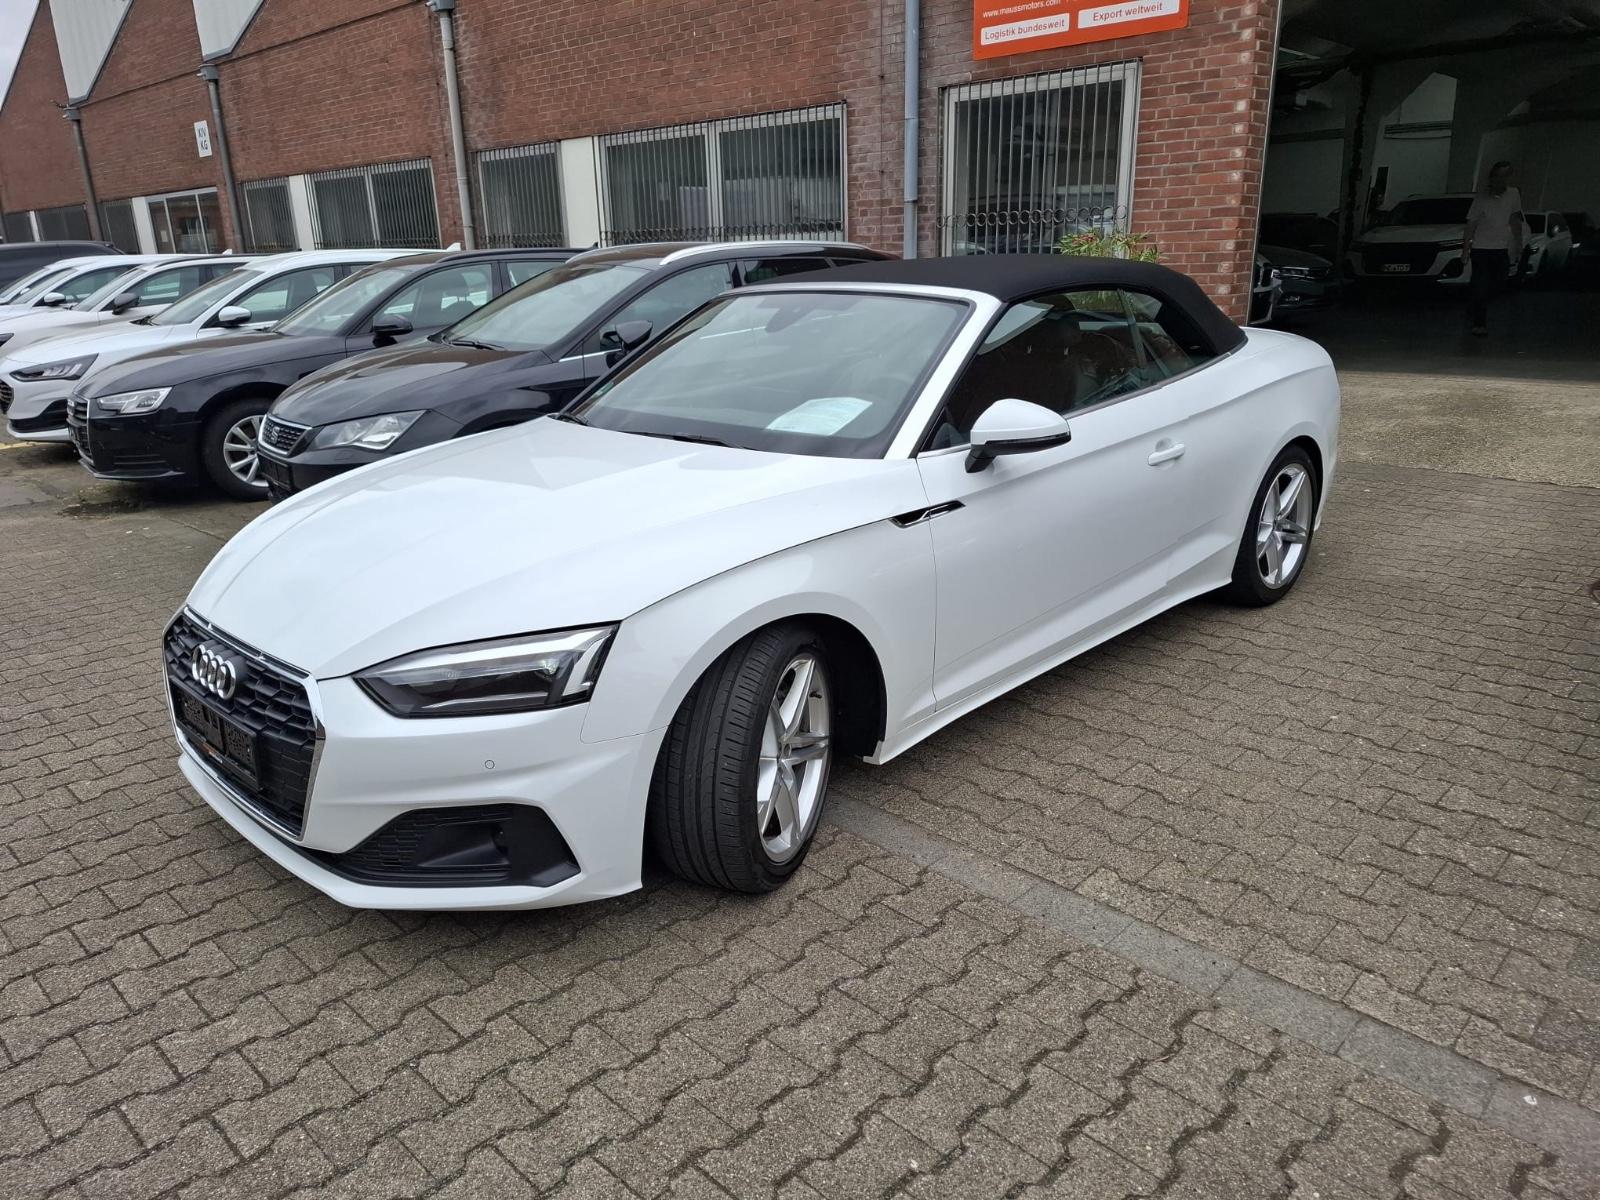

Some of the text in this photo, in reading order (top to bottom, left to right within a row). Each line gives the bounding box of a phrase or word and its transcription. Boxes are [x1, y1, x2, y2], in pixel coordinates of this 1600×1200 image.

[1093, 2, 1163, 21] Export weltweit
[985, 19, 1065, 40] Logistik bundesweit
